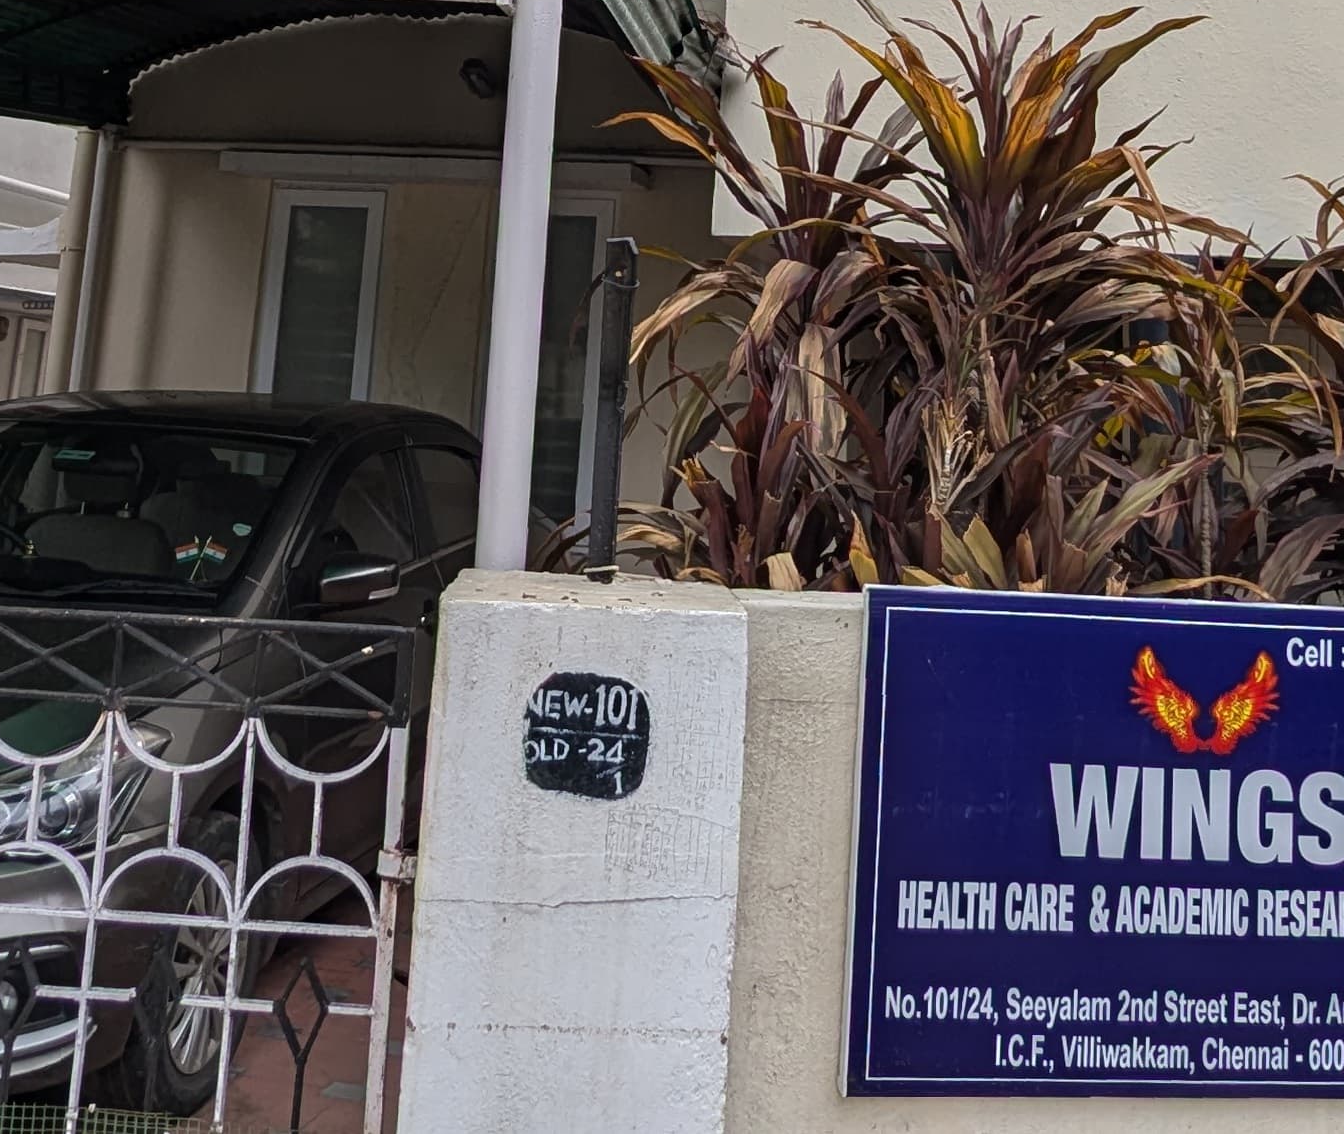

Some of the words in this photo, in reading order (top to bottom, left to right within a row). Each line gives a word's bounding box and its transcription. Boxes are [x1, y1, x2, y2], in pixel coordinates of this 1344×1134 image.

[1286, 636, 1333, 668] Cell
[897, 880, 997, 931] HEALTH
[1004, 882, 1075, 932] CARE
[1089, 885, 1109, 933] &
[1114, 886, 1249, 937] ACADEMIC
[885, 985, 999, 1026] No.101/24,
[1005, 987, 1111, 1029] Seeyalam
[1117, 989, 1158, 1023] 2nd
[1163, 989, 1228, 1024] Street
[1233, 991, 1286, 1030] East,
[1292, 992, 1321, 1025] Dr.
[995, 1033, 1054, 1074] I.C.F.,
[1061, 1035, 1195, 1075] Villiwakkam,
[1202, 1037, 1289, 1071] Chennai
